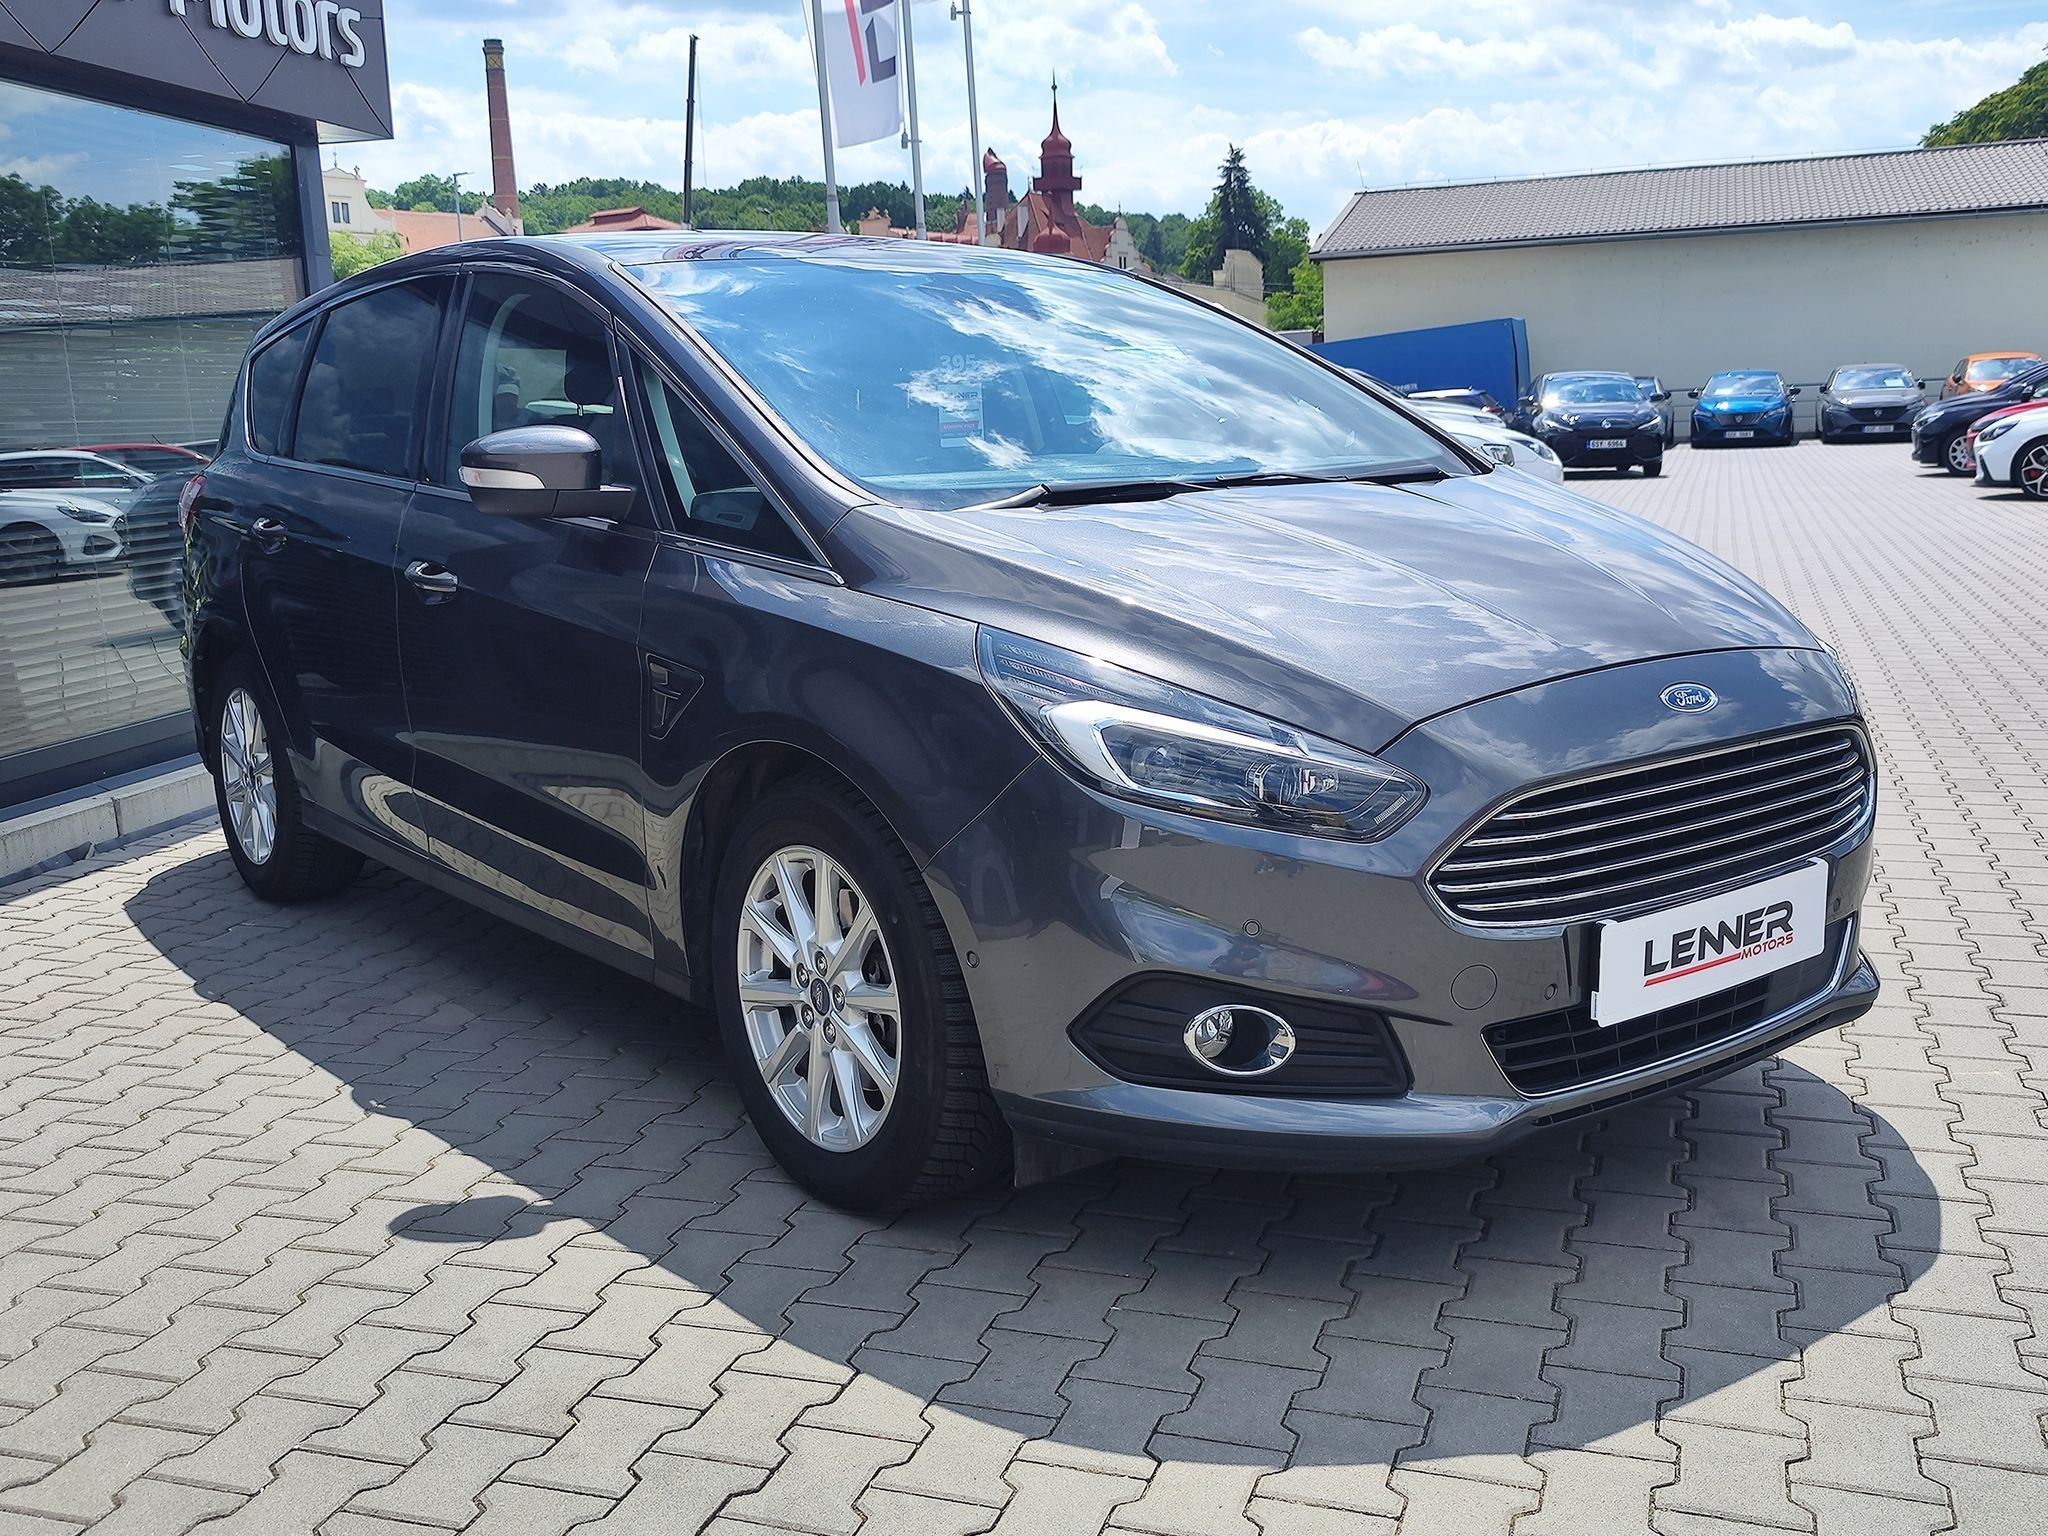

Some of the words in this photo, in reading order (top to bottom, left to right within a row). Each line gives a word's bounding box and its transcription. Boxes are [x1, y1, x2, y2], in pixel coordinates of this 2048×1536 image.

[167, 0, 366, 68] otors
[940, 353, 977, 373] 395
[1673, 687, 1706, 707] Ford
[1643, 900, 1794, 977] LENNER
[1740, 932, 1795, 961] MOTORS
